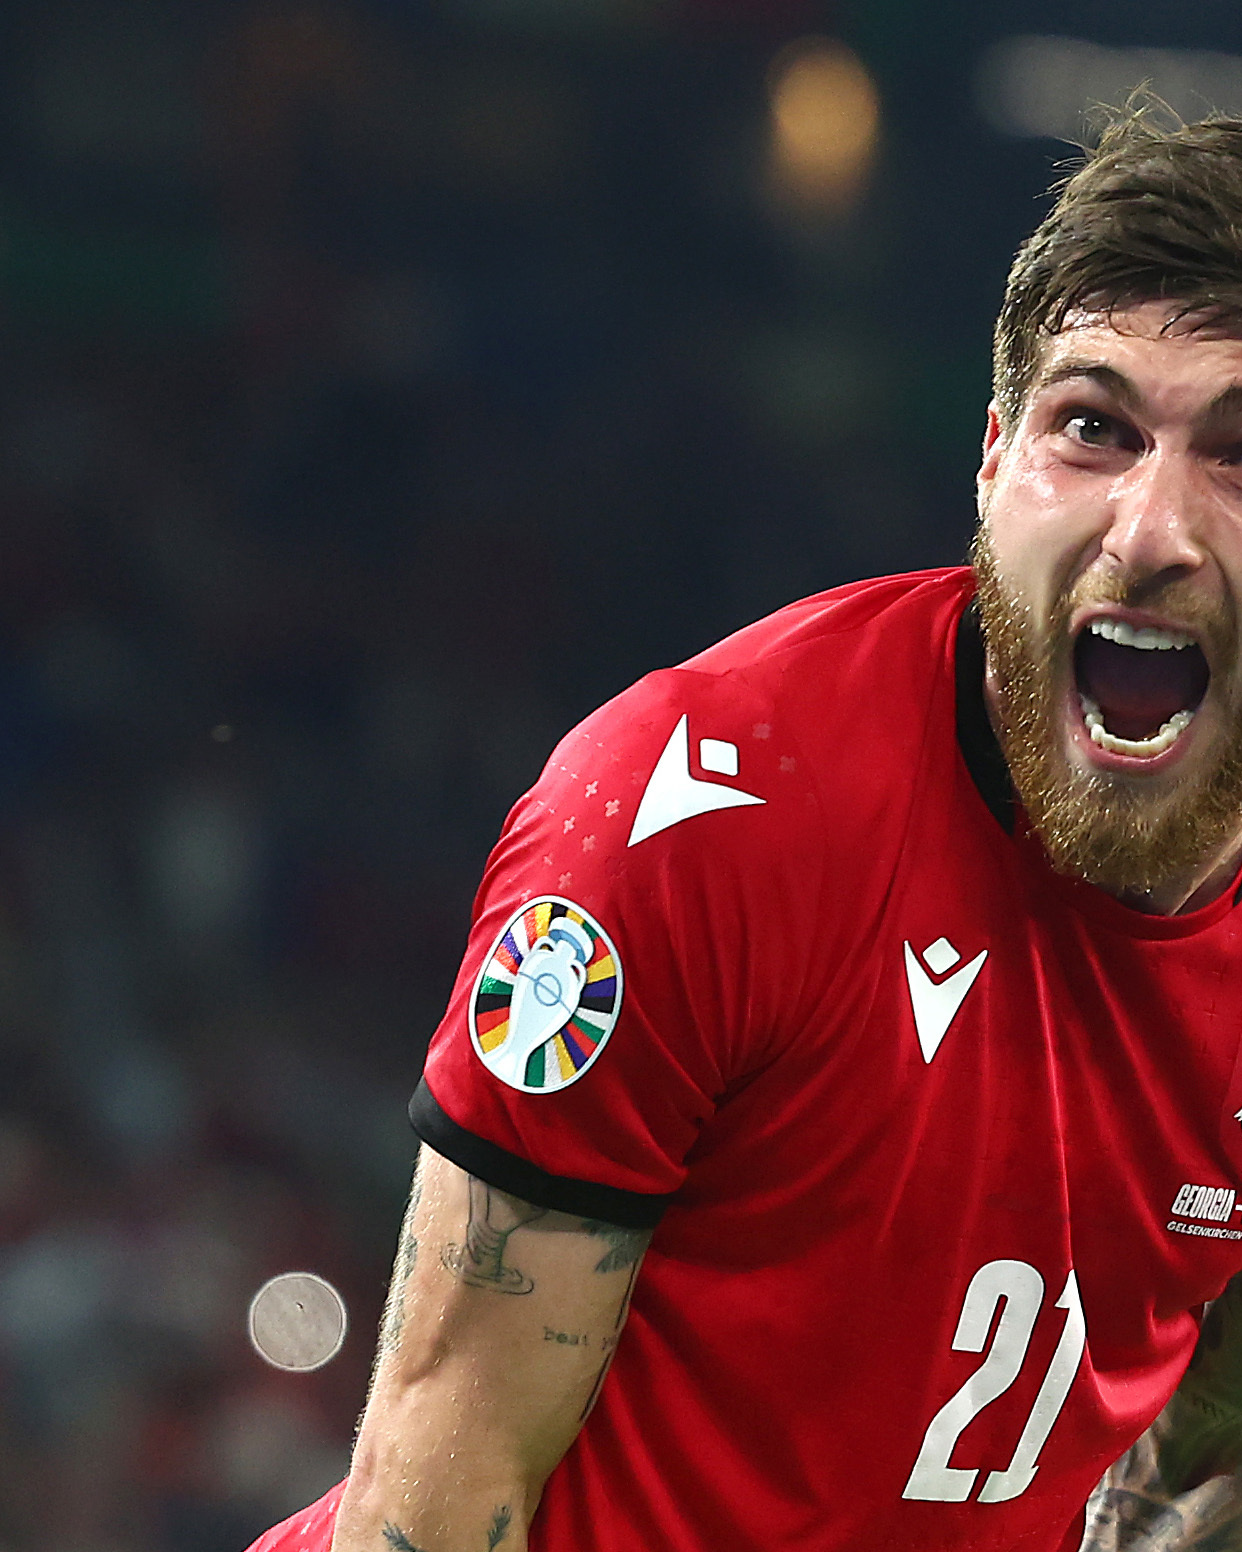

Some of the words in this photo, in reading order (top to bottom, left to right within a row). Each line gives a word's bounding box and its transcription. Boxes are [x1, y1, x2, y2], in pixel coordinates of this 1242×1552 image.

[1171, 1183, 1236, 1222] GEORGIA
[1166, 1220, 1242, 1240] GELSENKIRCHEN
[901, 1258, 1087, 1503] 21
